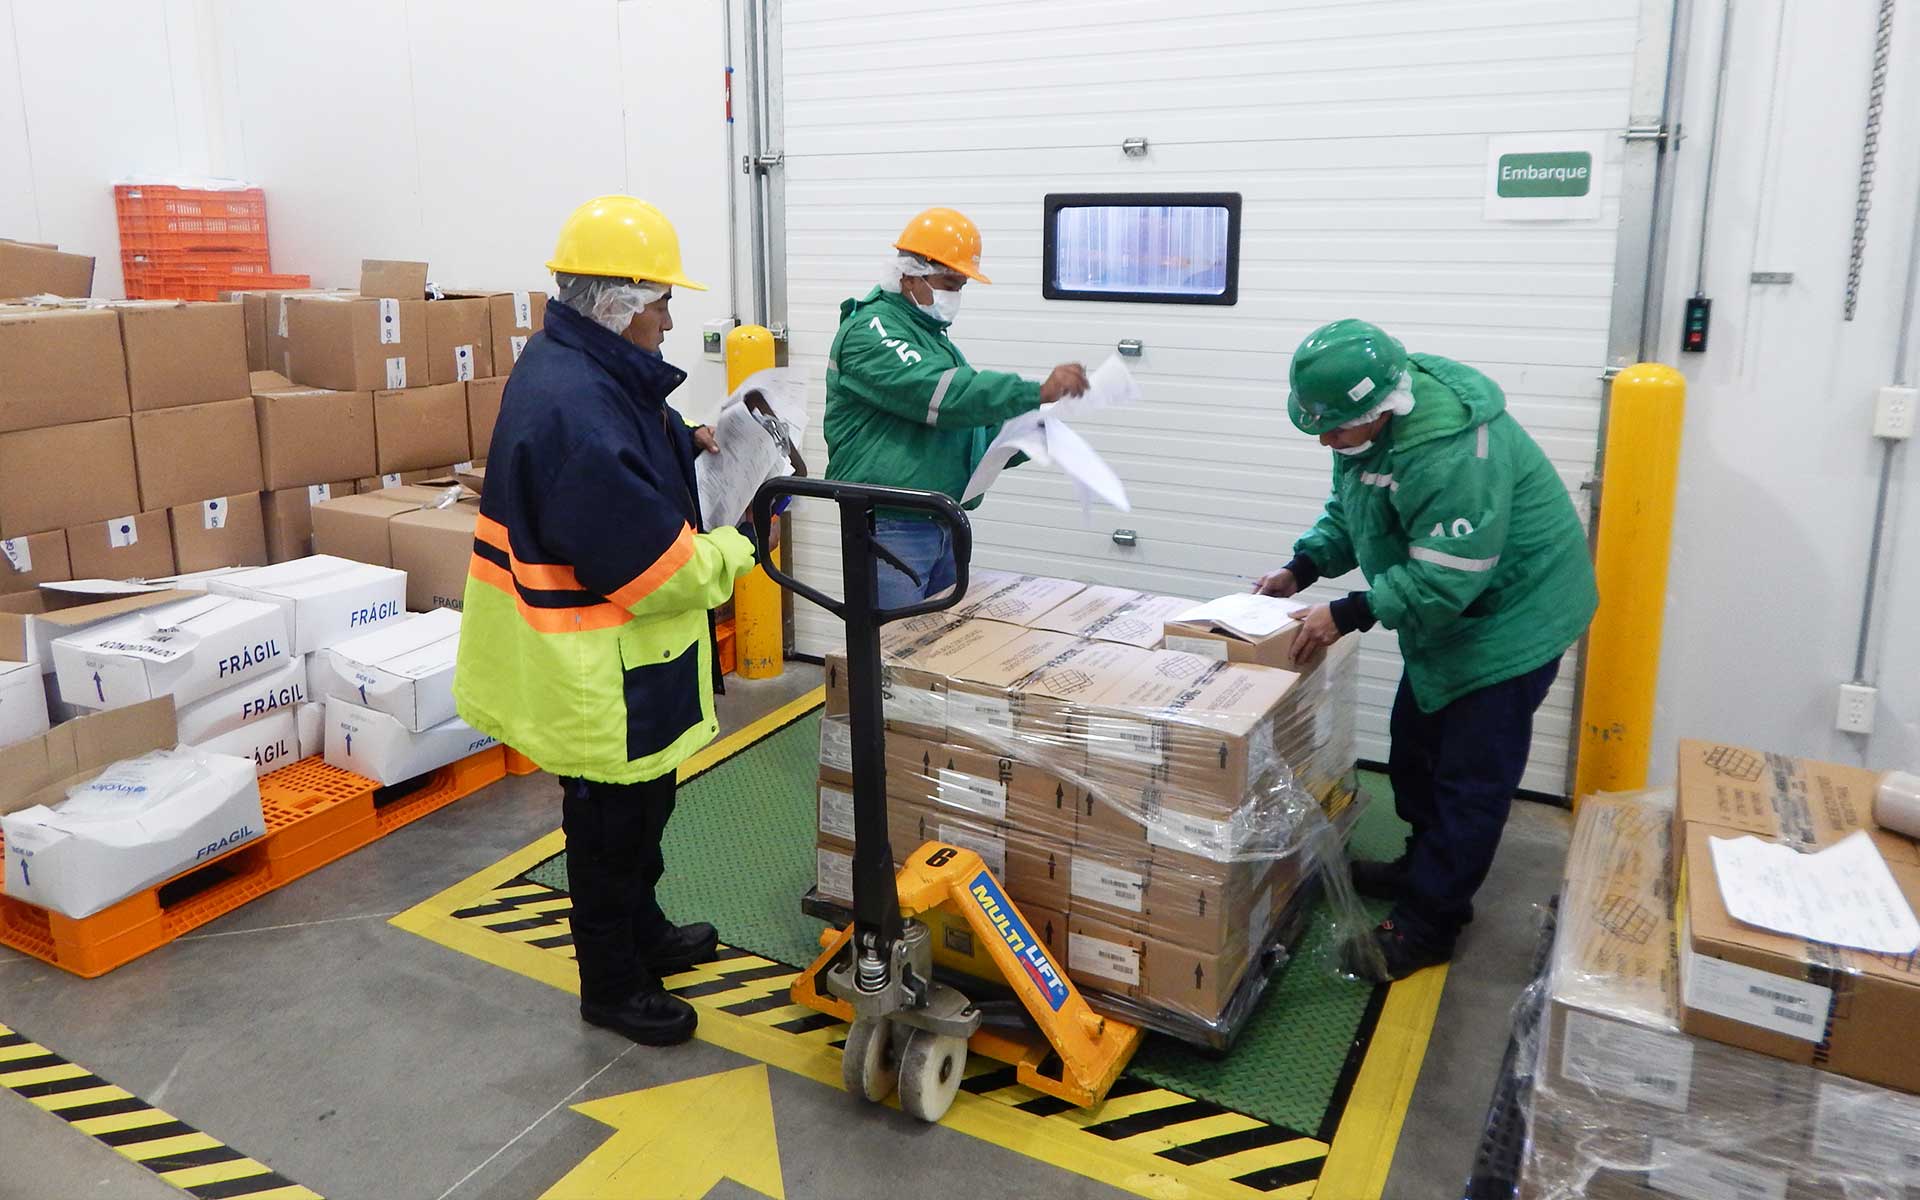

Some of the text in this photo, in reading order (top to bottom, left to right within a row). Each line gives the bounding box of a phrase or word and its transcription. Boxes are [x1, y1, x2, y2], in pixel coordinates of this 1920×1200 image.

[1502, 164, 1588, 182] Embarque
[350, 599, 399, 628] FRÁGIL
[218, 639, 281, 678] FRÁGIL
[242, 683, 304, 720] FRÁGIL
[925, 847, 958, 867] 6
[973, 884, 1063, 989] MULTI LIFT
